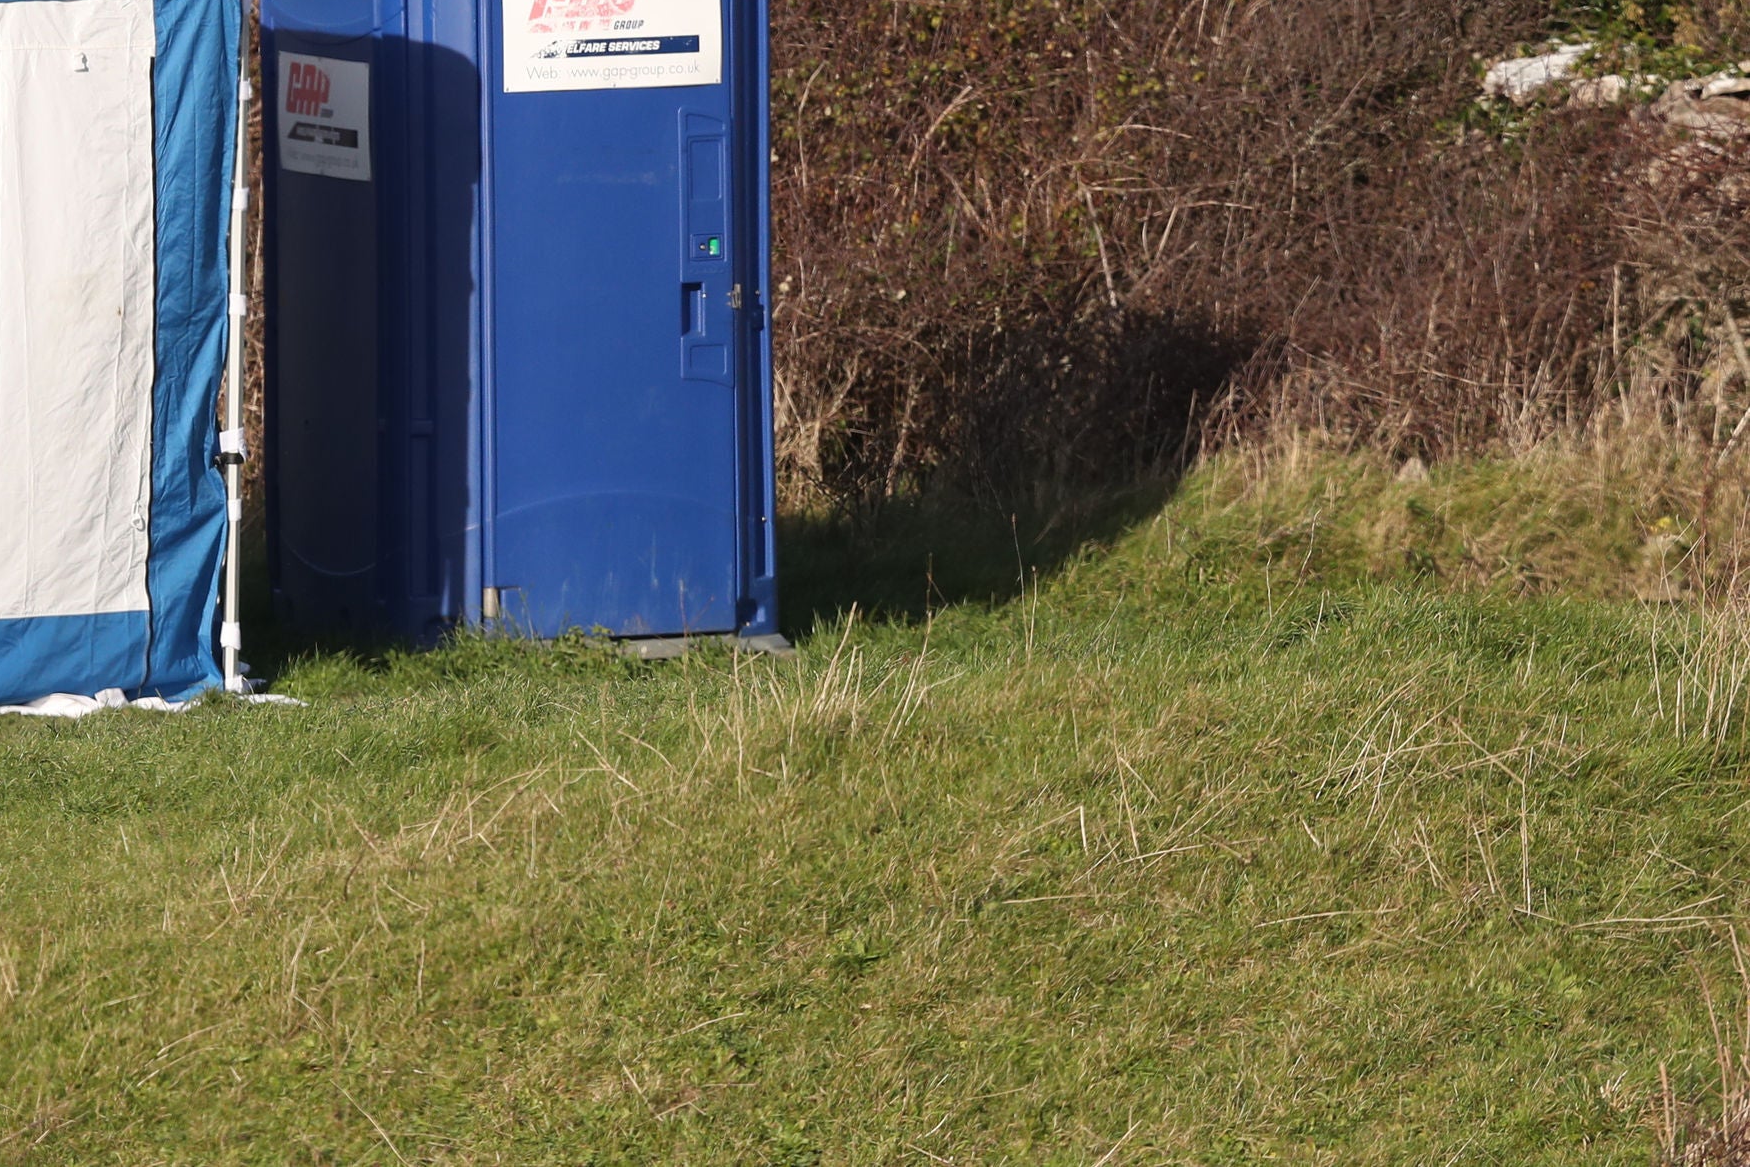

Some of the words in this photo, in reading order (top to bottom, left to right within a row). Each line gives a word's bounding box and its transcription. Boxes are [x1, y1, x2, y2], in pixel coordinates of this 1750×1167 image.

[613, 19, 645, 31] GROUP
[553, 42, 608, 55] ELFARE
[607, 40, 661, 52] SERVICES
[571, 59, 700, 81] www.gap-group.co.uk
